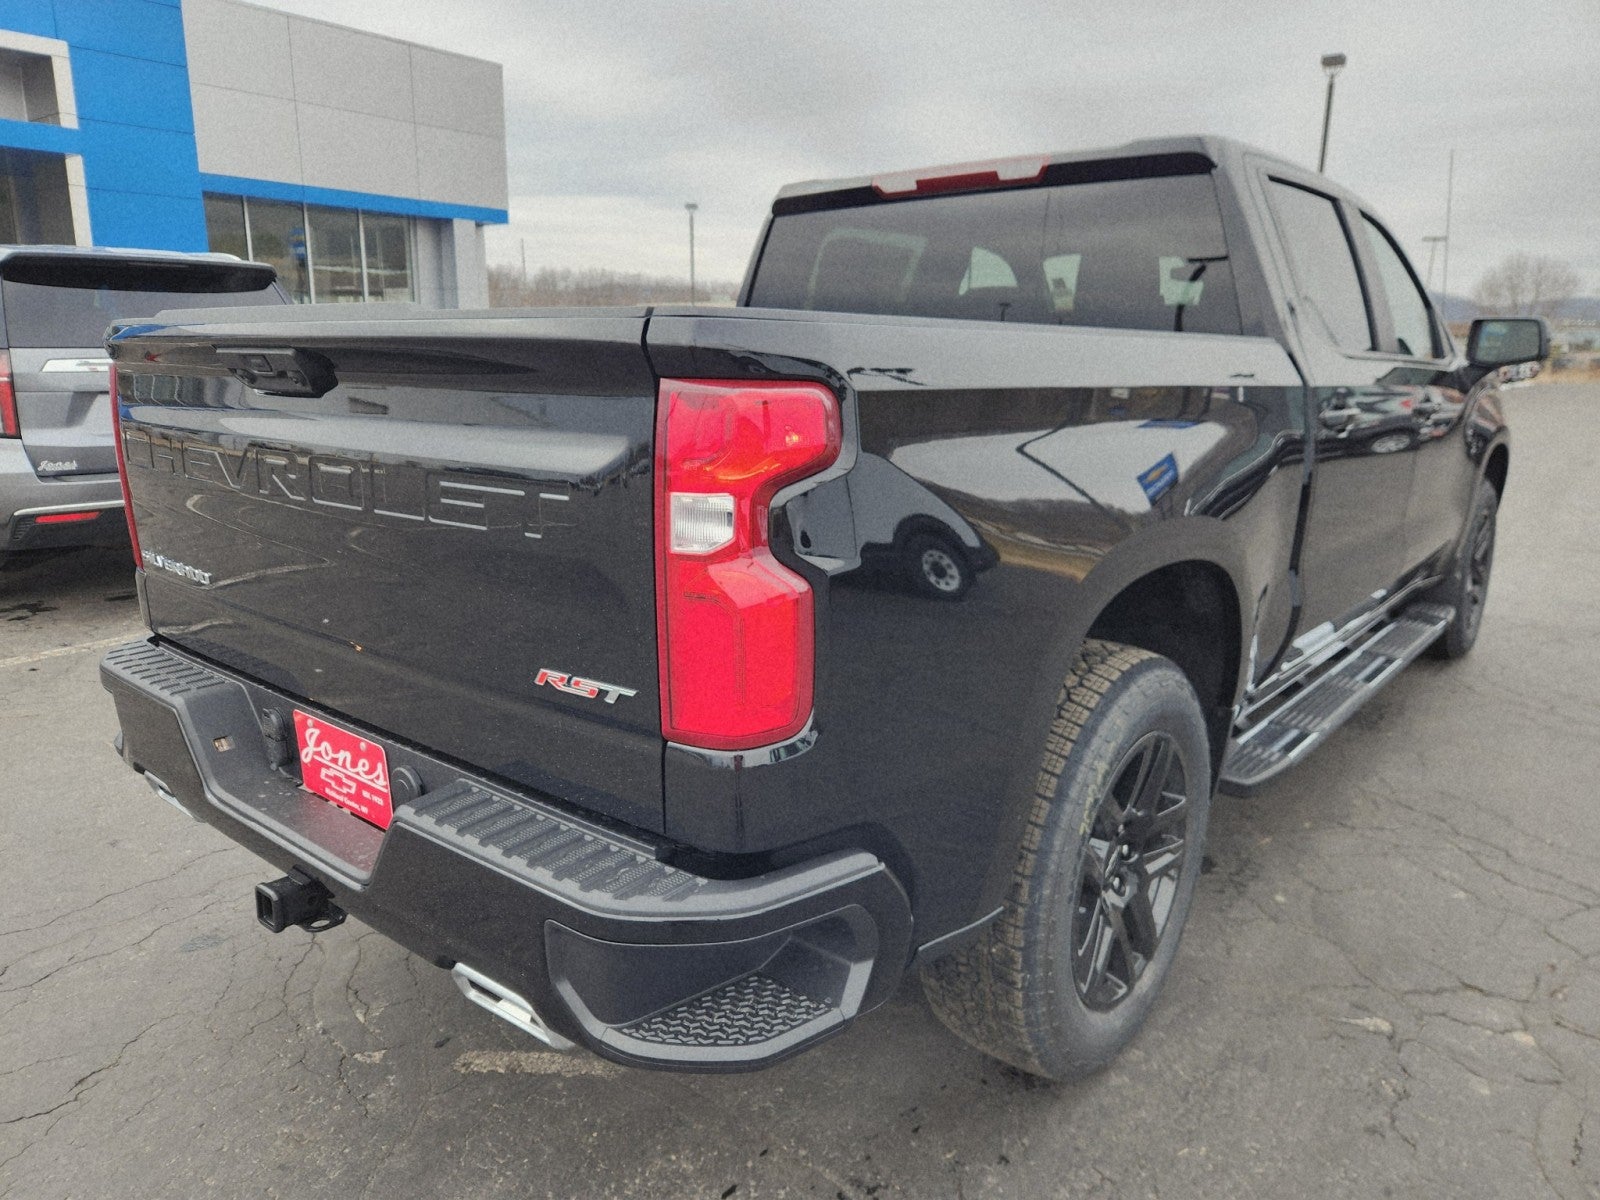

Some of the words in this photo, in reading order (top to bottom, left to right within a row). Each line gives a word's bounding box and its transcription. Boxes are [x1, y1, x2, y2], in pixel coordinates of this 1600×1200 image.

[124, 430, 571, 539] CHEVROLET
[533, 668, 639, 705] RST
[301, 727, 388, 787] Jones
